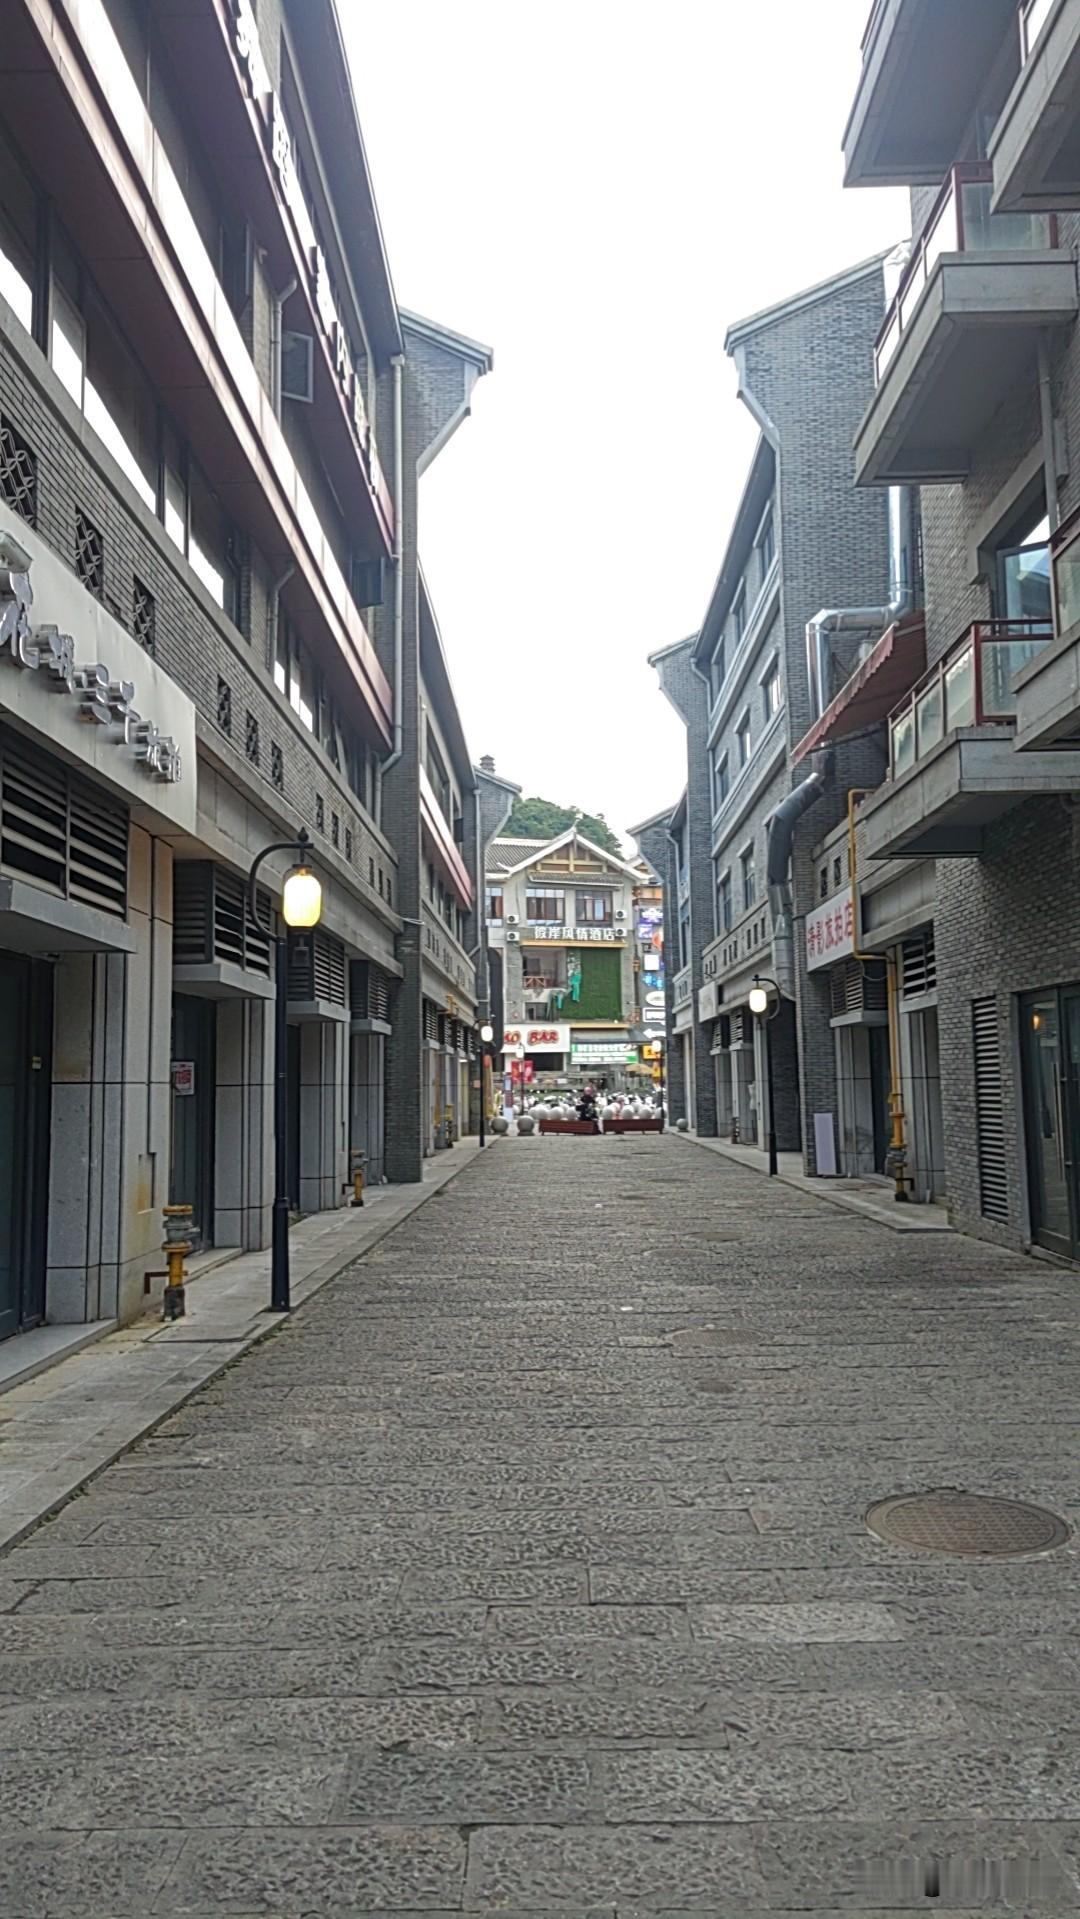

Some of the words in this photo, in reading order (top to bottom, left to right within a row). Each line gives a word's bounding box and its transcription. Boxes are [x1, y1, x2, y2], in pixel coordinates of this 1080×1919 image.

[535, 925, 615, 941] 彼岸风情酒店
[528, 1029, 559, 1046] BAR
